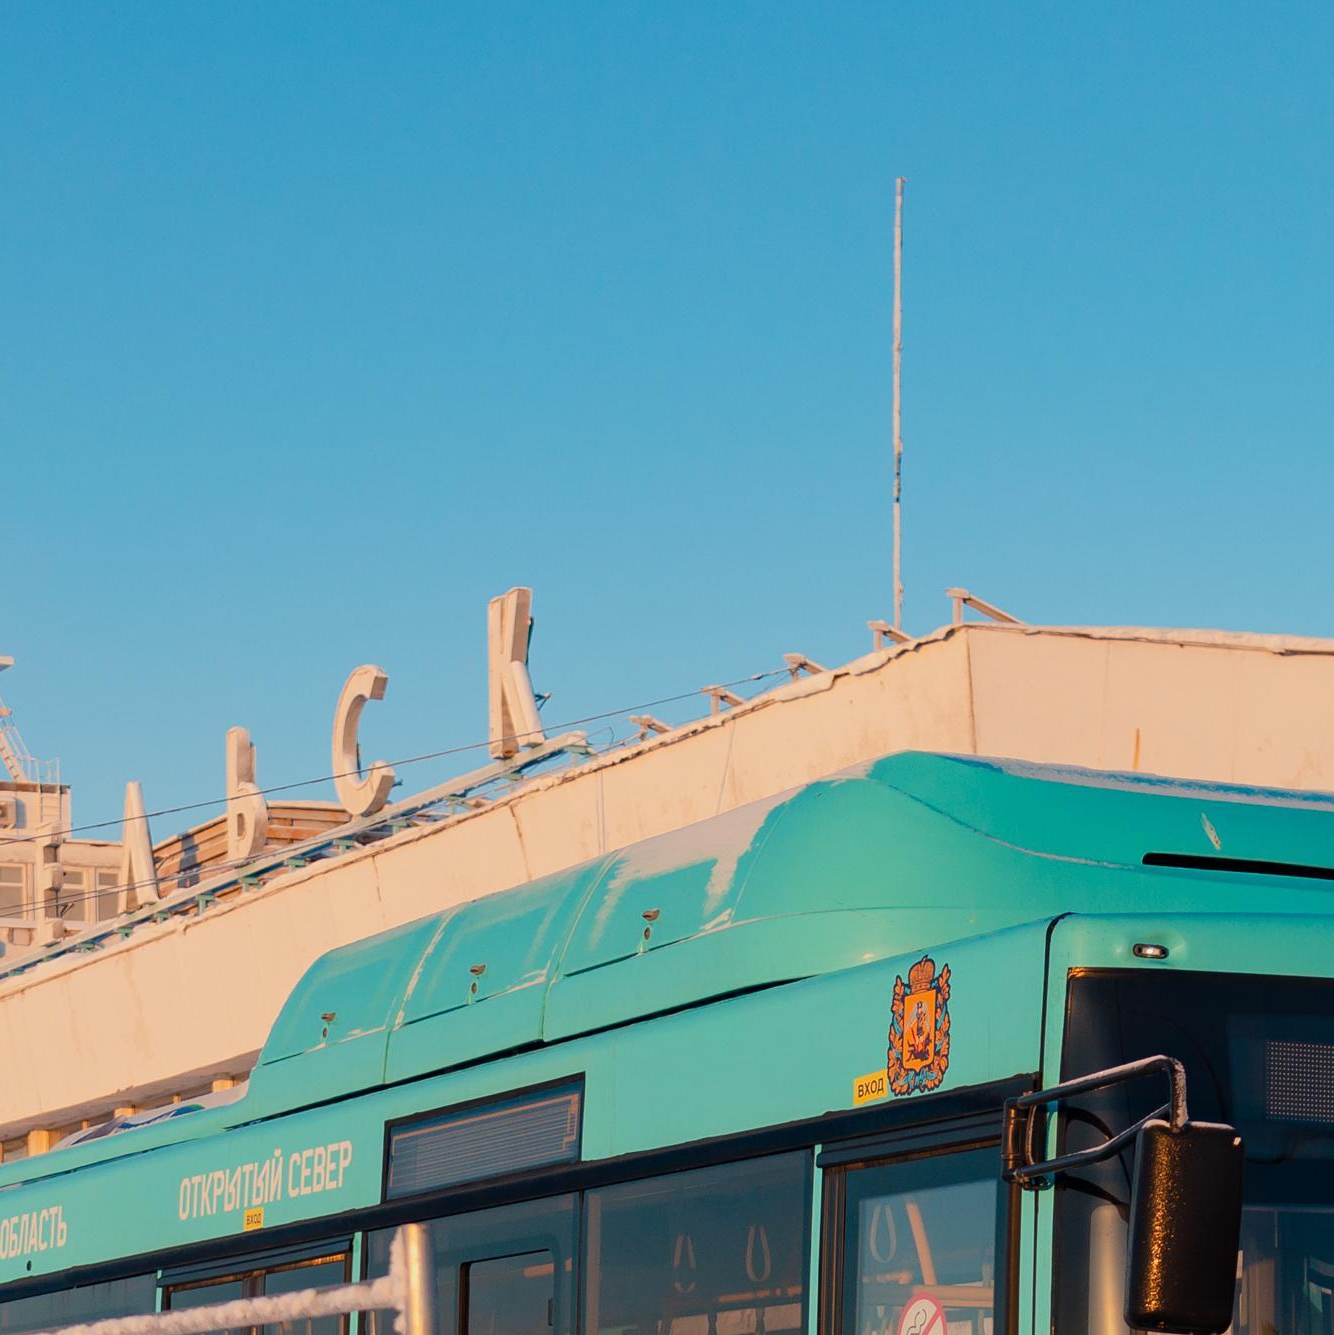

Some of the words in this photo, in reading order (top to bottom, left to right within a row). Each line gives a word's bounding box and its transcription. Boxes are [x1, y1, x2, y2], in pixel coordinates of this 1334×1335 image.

[858, 1077, 884, 1098] ВХОД
[179, 1148, 283, 1220] ОТКРЫТЫЙ
[288, 1140, 353, 1198] СЕВЕР
[0, 1205, 67, 1260] ОБЛАСТЬ
[246, 1212, 262, 1225] ВХОД
